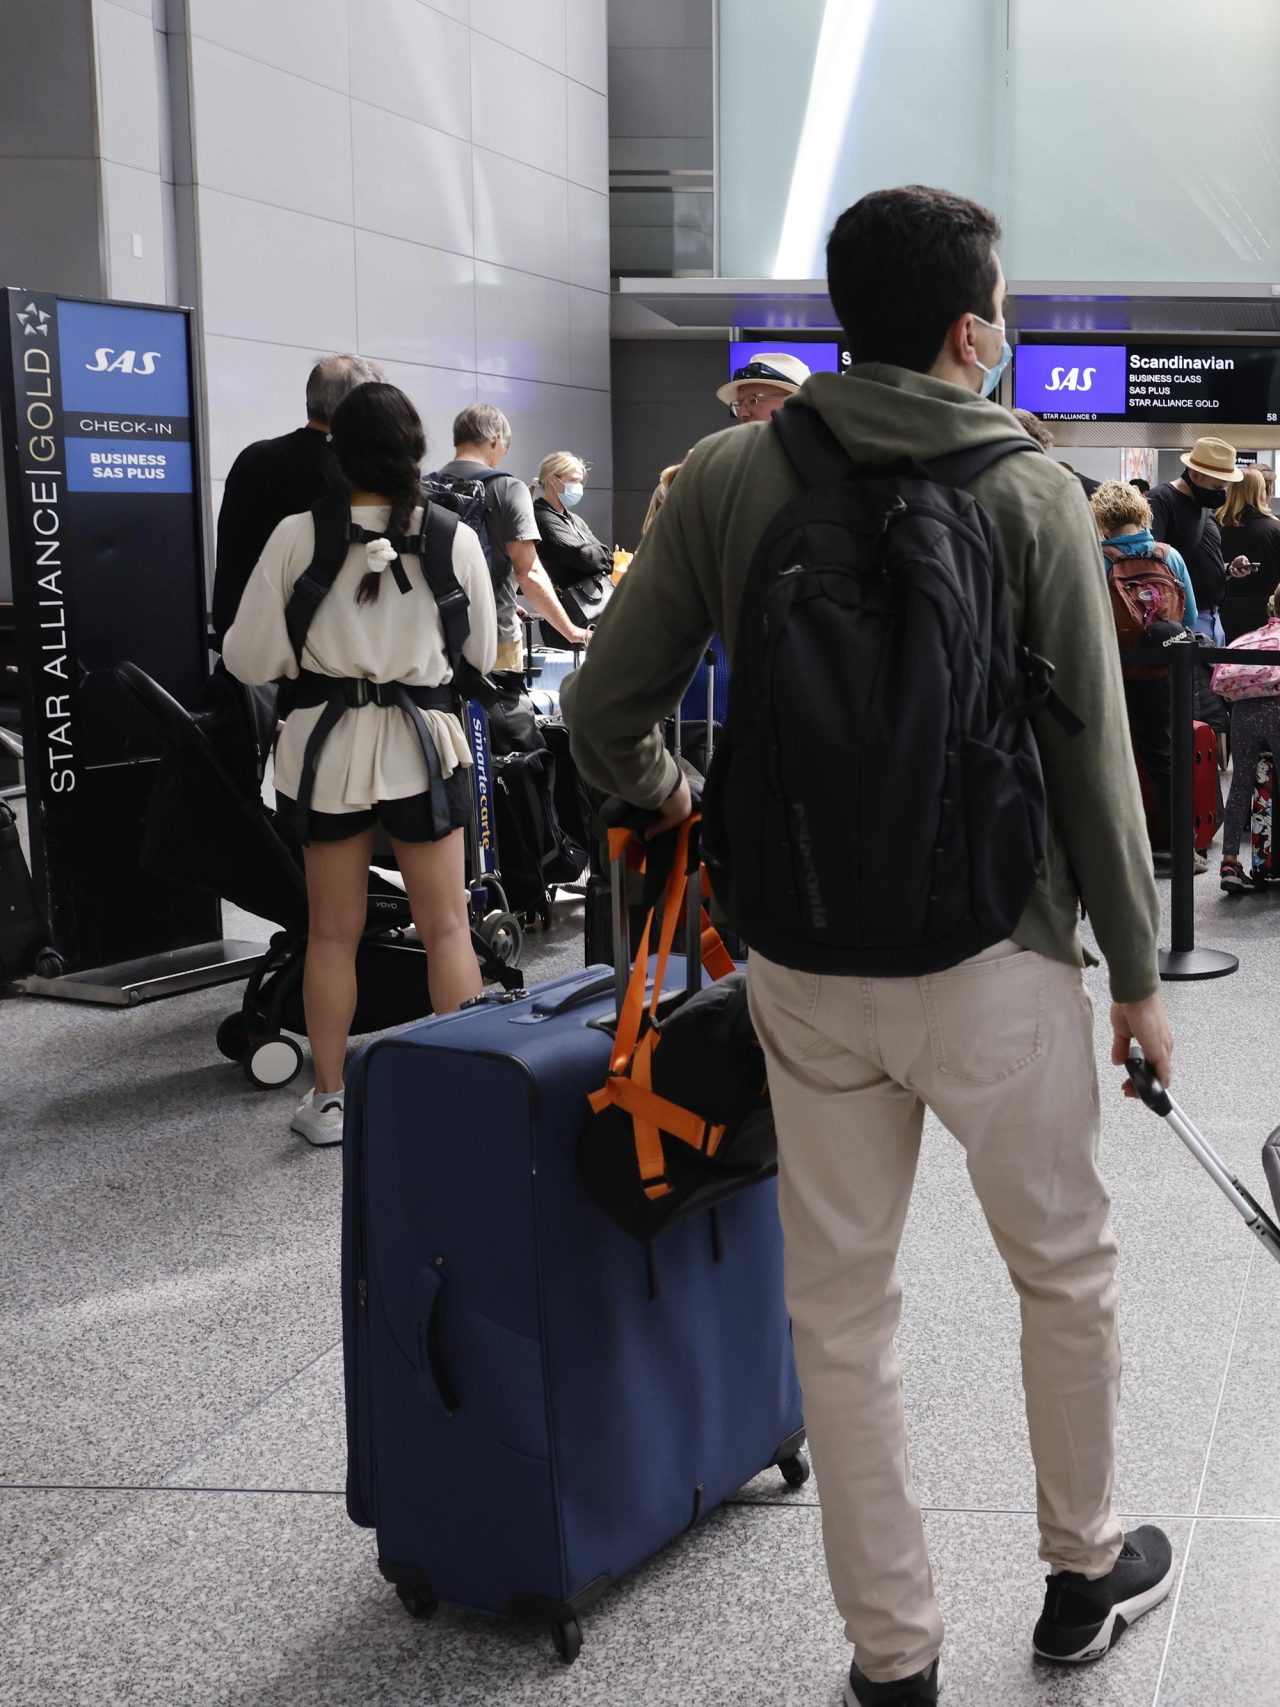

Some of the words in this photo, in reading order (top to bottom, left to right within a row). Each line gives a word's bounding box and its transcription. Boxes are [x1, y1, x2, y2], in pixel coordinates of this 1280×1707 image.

[85, 347, 161, 375] SAS
[1130, 354, 1235, 370] Scandinavian
[1044, 367, 1097, 392] SAS
[1129, 374, 1172, 383] BUSINESS
[1174, 375, 1202, 384] CLASS
[1129, 386, 1146, 395] SAS
[1148, 387, 1170, 395] PLUS
[25, 348, 56, 461] GOLD
[1129, 399, 1152, 407] STAR
[1152, 399, 1193, 408] ALLIANCE
[1195, 400, 1220, 408] GOLD
[1266, 412, 1278, 422] 58
[79, 419, 172, 435] CHECK-IN
[90, 452, 167, 466] BUSINESS
[92, 467, 123, 478] SAS
[127, 468, 165, 479] PLUS
[33, 482, 68, 679] ALLIANCE
[46, 693, 75, 792] STAR
